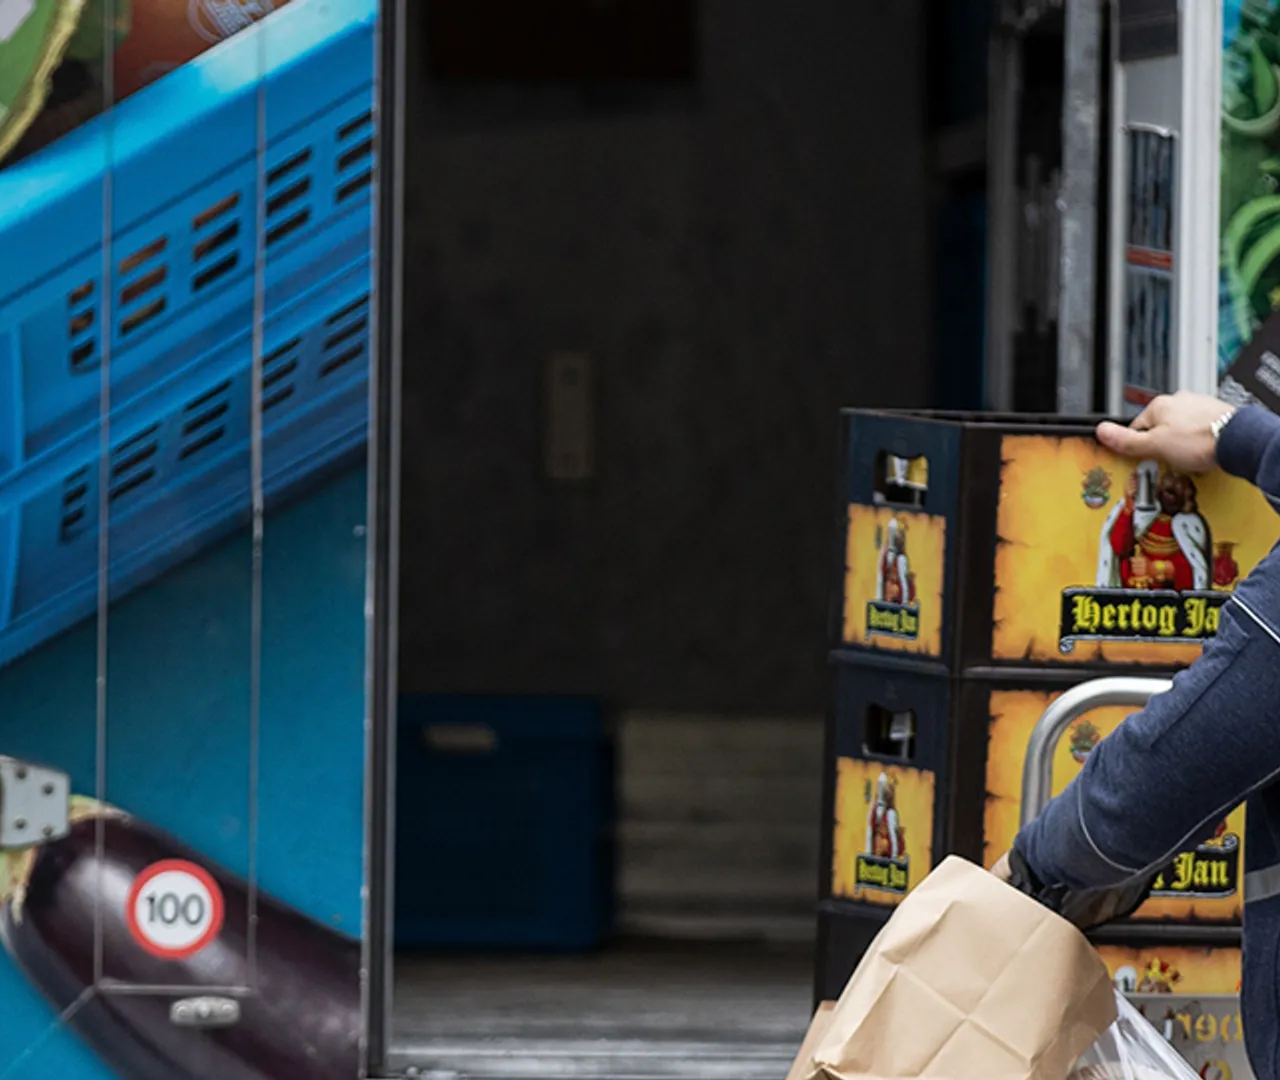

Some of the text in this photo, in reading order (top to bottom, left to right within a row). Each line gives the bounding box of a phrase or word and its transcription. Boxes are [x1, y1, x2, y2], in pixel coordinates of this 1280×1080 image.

[1072, 595, 1221, 636] Hertog Ja
[1170, 851, 1230, 890] Jan
[145, 892, 205, 926] 100
